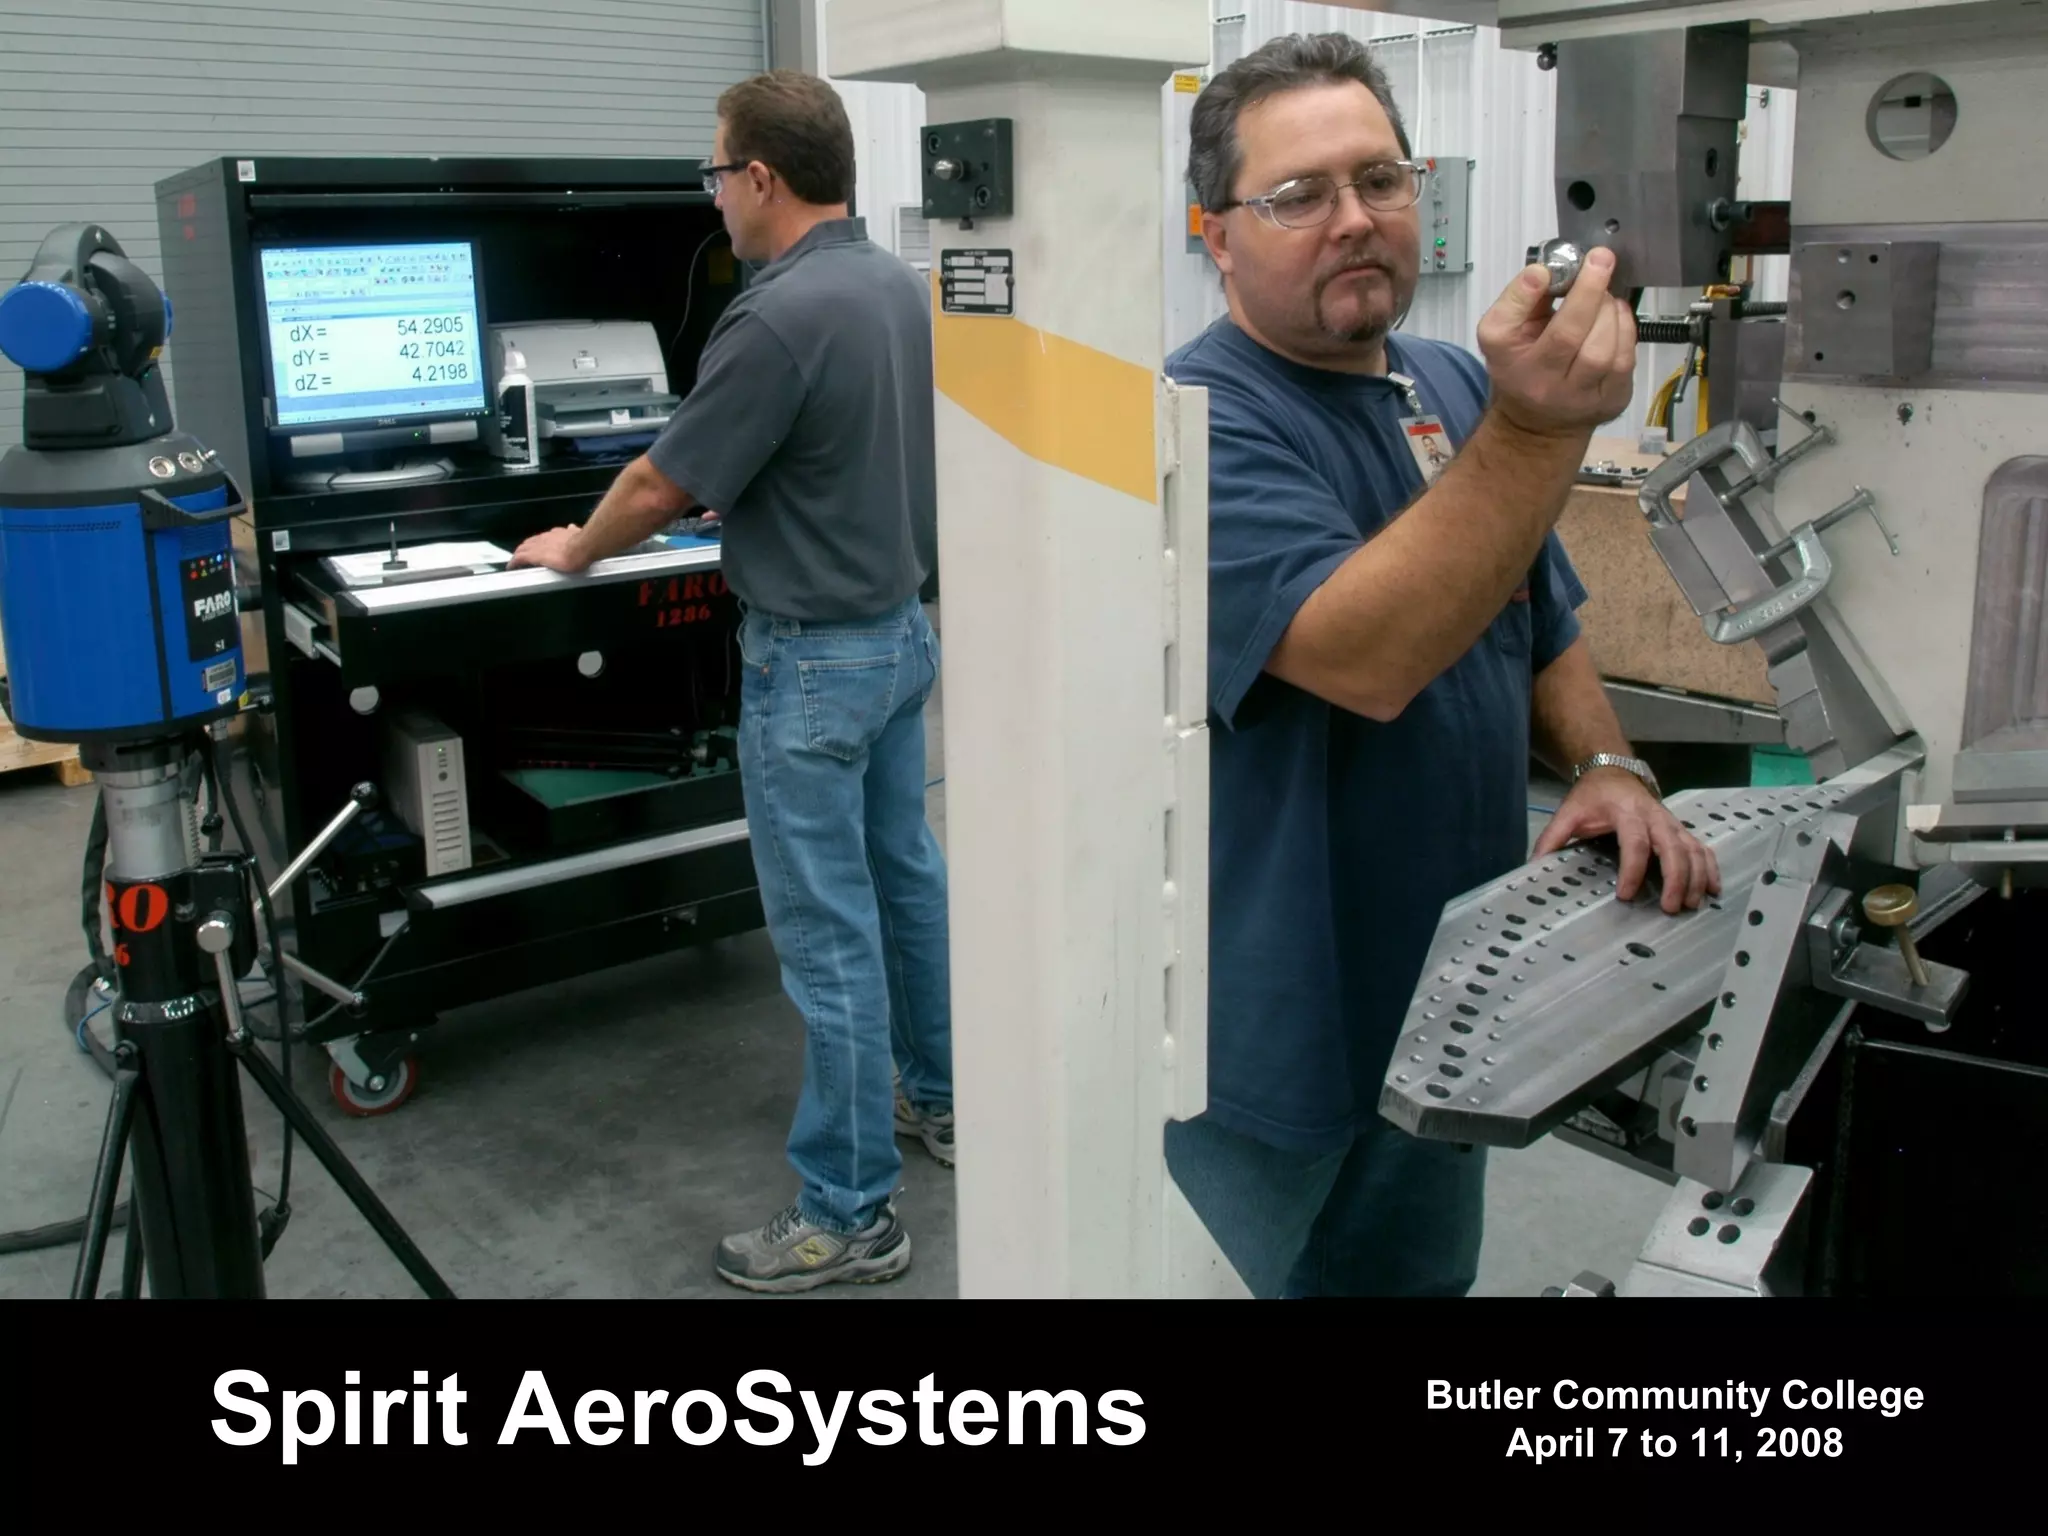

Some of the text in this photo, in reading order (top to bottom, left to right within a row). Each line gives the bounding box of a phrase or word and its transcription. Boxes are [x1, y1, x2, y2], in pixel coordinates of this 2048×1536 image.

[398, 316, 464, 335] 54.2905
[400, 340, 465, 359] 42.7042
[412, 363, 468, 382] 4.2198
[638, 573, 728, 606] FARO
[194, 590, 231, 617] FARO
[655, 604, 711, 627] 1286
